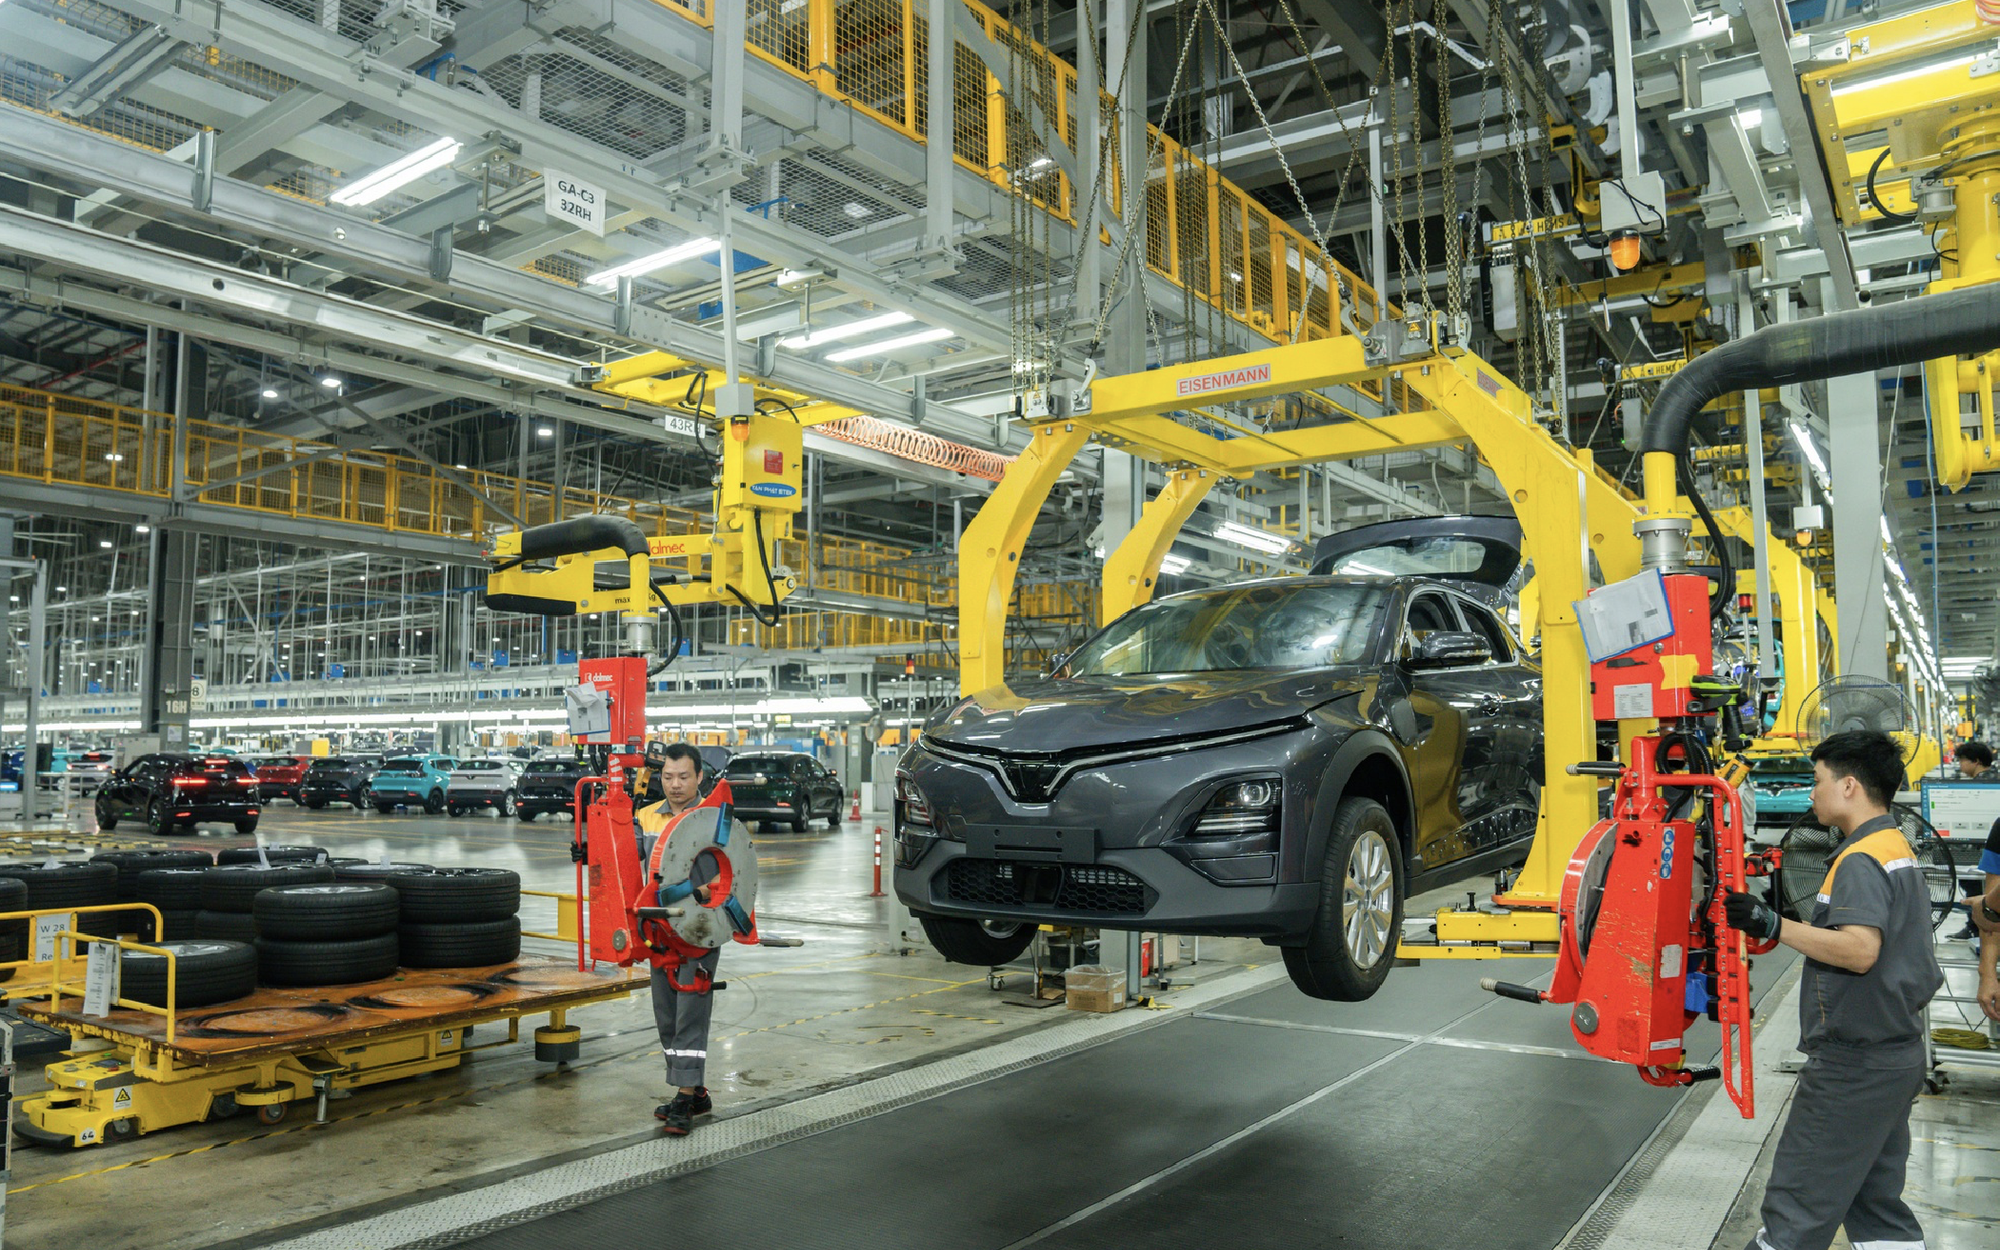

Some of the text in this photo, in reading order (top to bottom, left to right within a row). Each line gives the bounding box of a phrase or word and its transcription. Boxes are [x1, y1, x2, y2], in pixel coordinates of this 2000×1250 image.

[558, 180, 595, 204] GA-C3
[560, 199, 592, 222] 32RH
[1179, 366, 1268, 394] EISENMANN
[670, 418, 701, 435] 43R
[166, 700, 187, 714] 16H
[40, 924, 66, 933] W 28
[82, 1131, 94, 1140] 64
